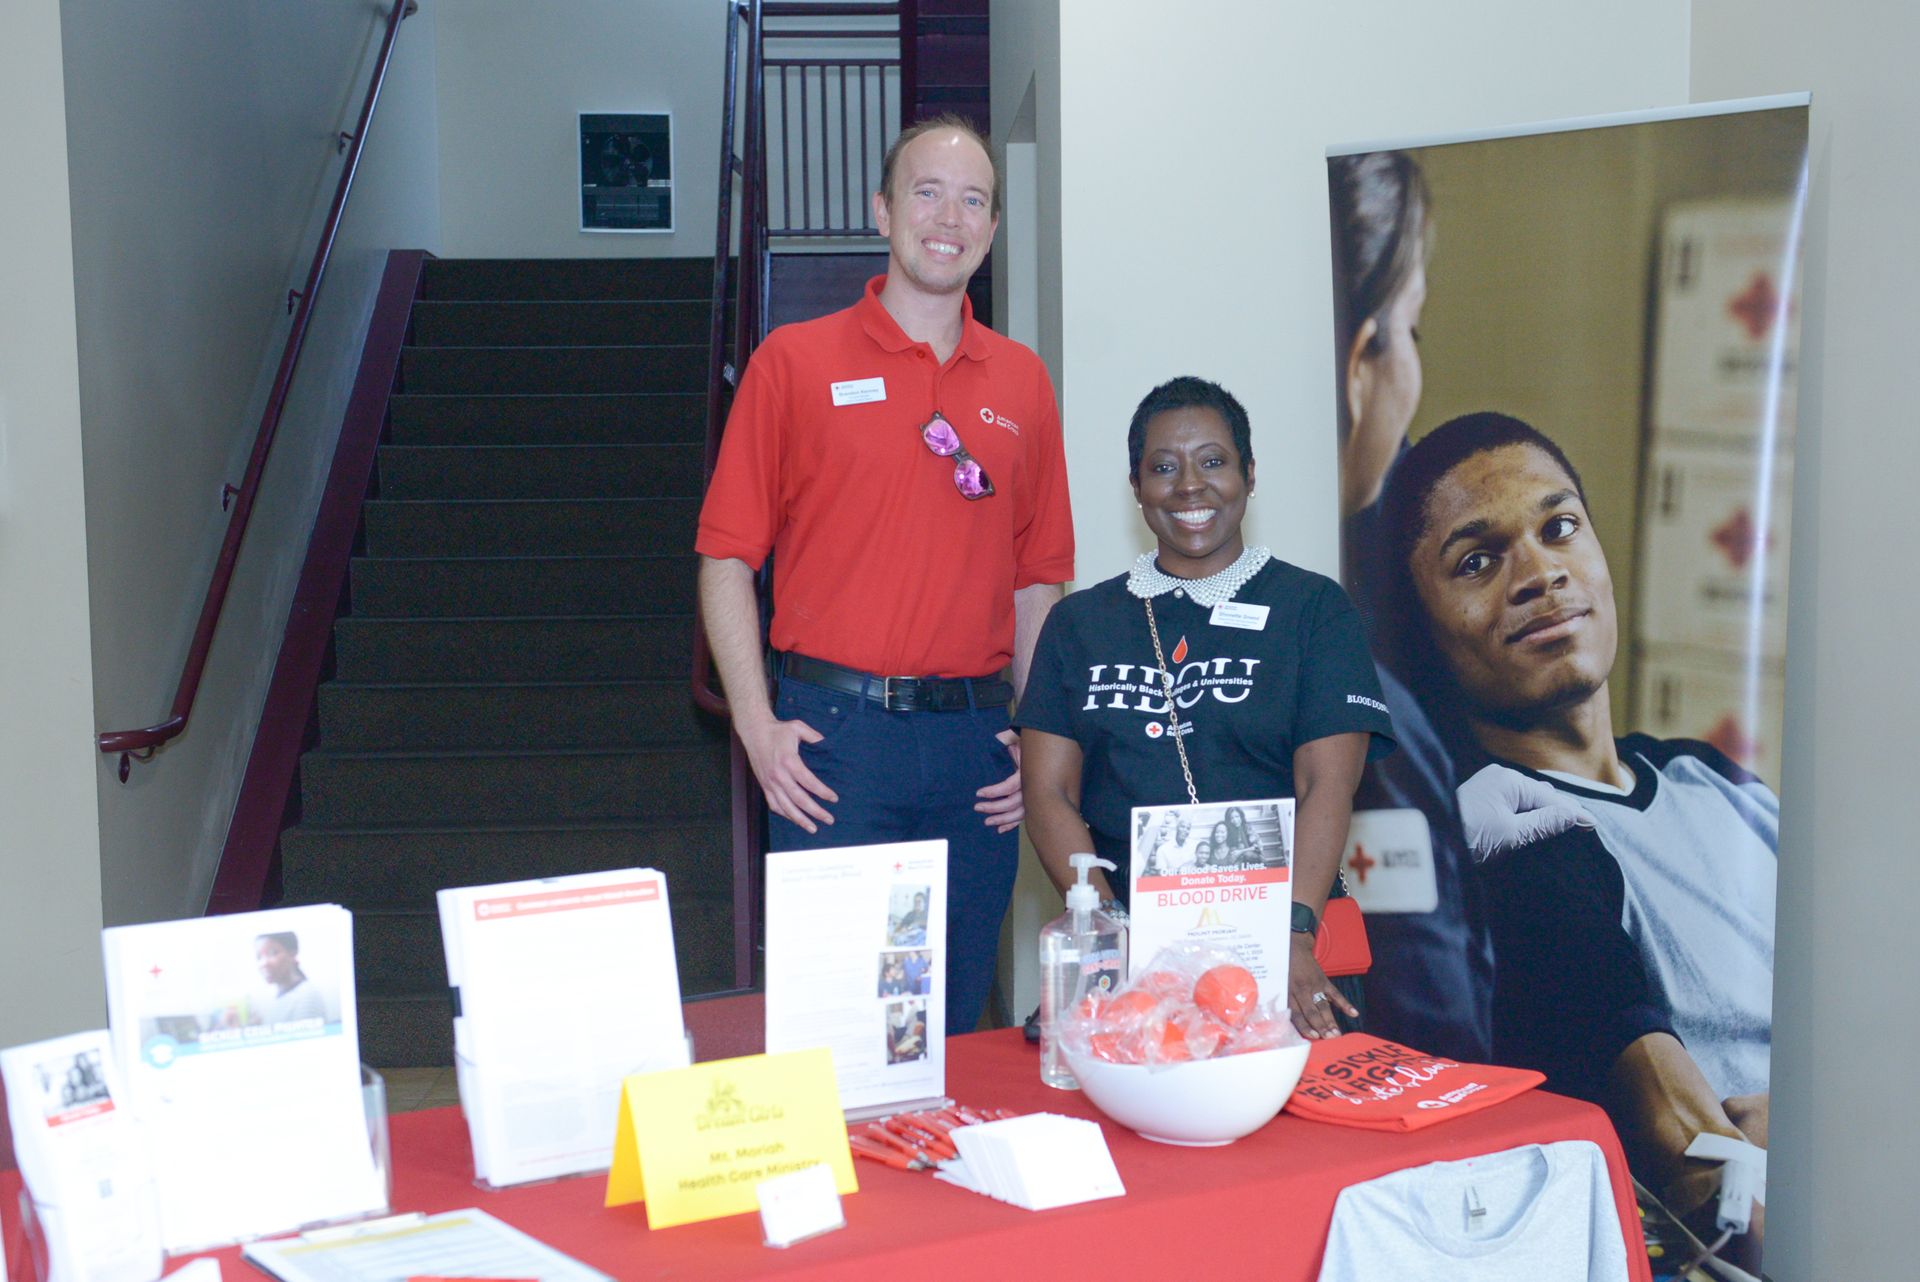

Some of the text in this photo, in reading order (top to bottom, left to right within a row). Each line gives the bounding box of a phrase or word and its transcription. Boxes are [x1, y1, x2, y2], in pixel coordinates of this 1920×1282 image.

[1083, 657, 1261, 714] HBCU
[1089, 683, 1137, 693] Historically
[1139, 685, 1164, 698] Black
[1192, 680, 1199, 688] &
[1201, 676, 1254, 687] Universities
[1346, 694, 1372, 707] BLOOD
[1161, 861, 1268, 877] Our Blood Saves Lives.
[1180, 874, 1247, 886] Donate Today.
[1157, 886, 1268, 907] BLOOD DRIVE
[735, 1142, 785, 1159] Moriah
[678, 1173, 726, 1190] Health
[728, 1169, 762, 1183] Care
